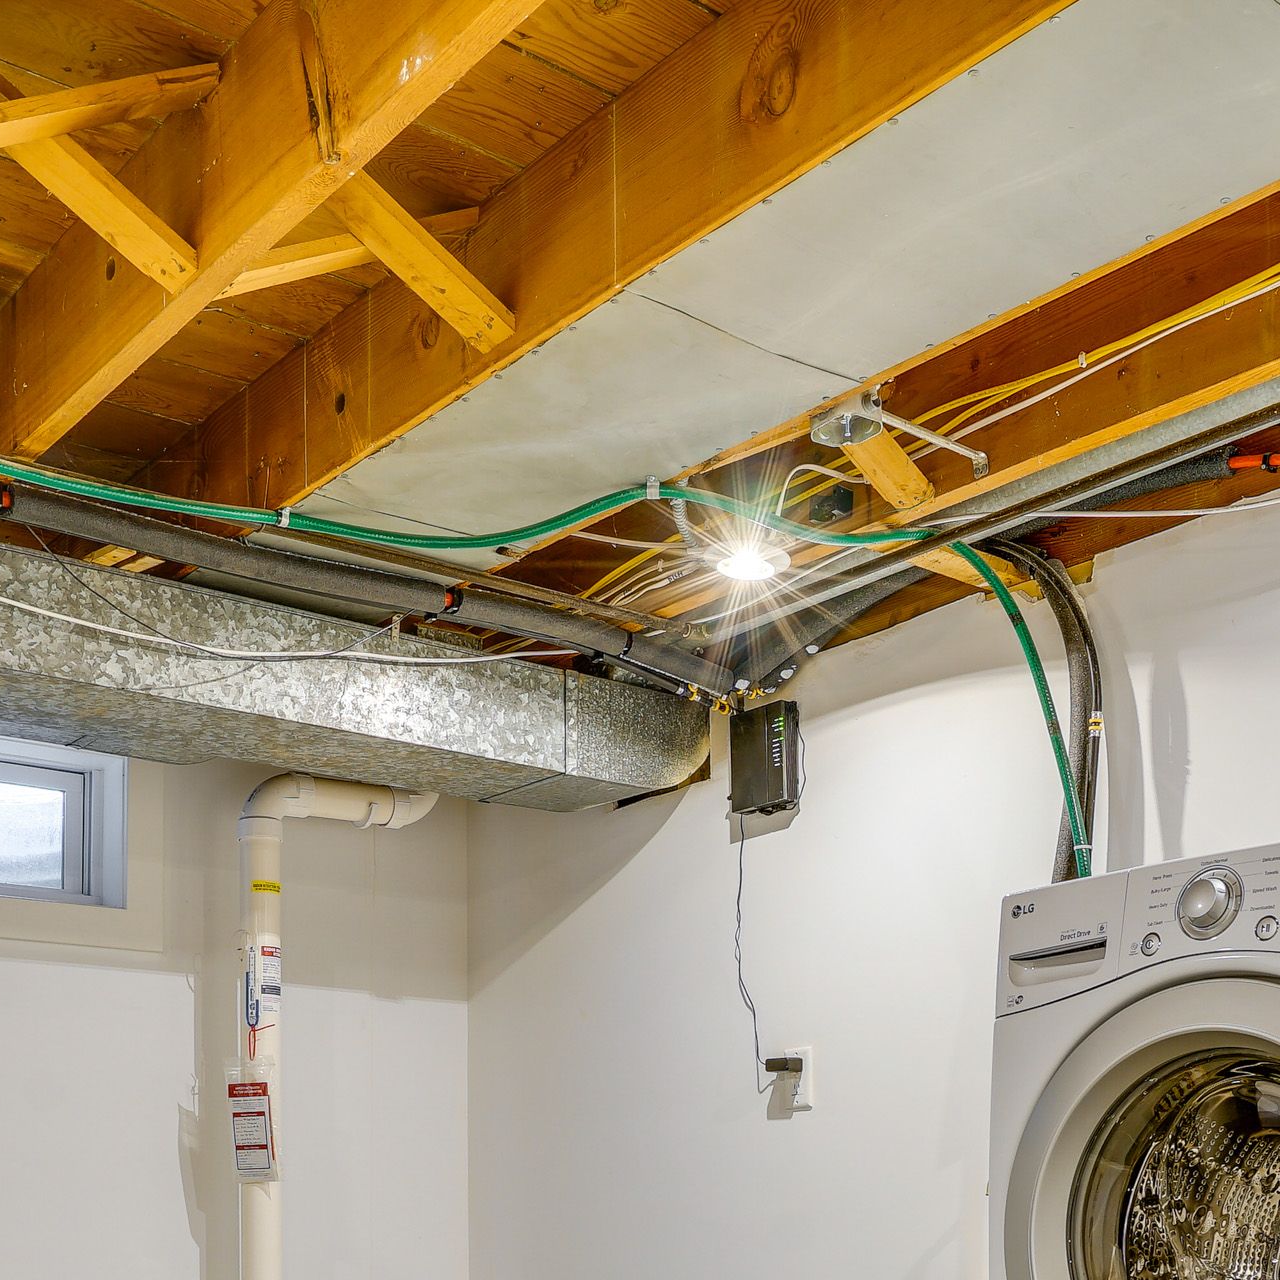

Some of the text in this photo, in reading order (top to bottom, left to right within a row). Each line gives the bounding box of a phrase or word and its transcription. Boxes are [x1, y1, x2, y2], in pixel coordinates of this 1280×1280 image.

[1022, 903, 1035, 915] LG
[1060, 933, 1076, 941] Direct
[1077, 930, 1091, 938] Drive
